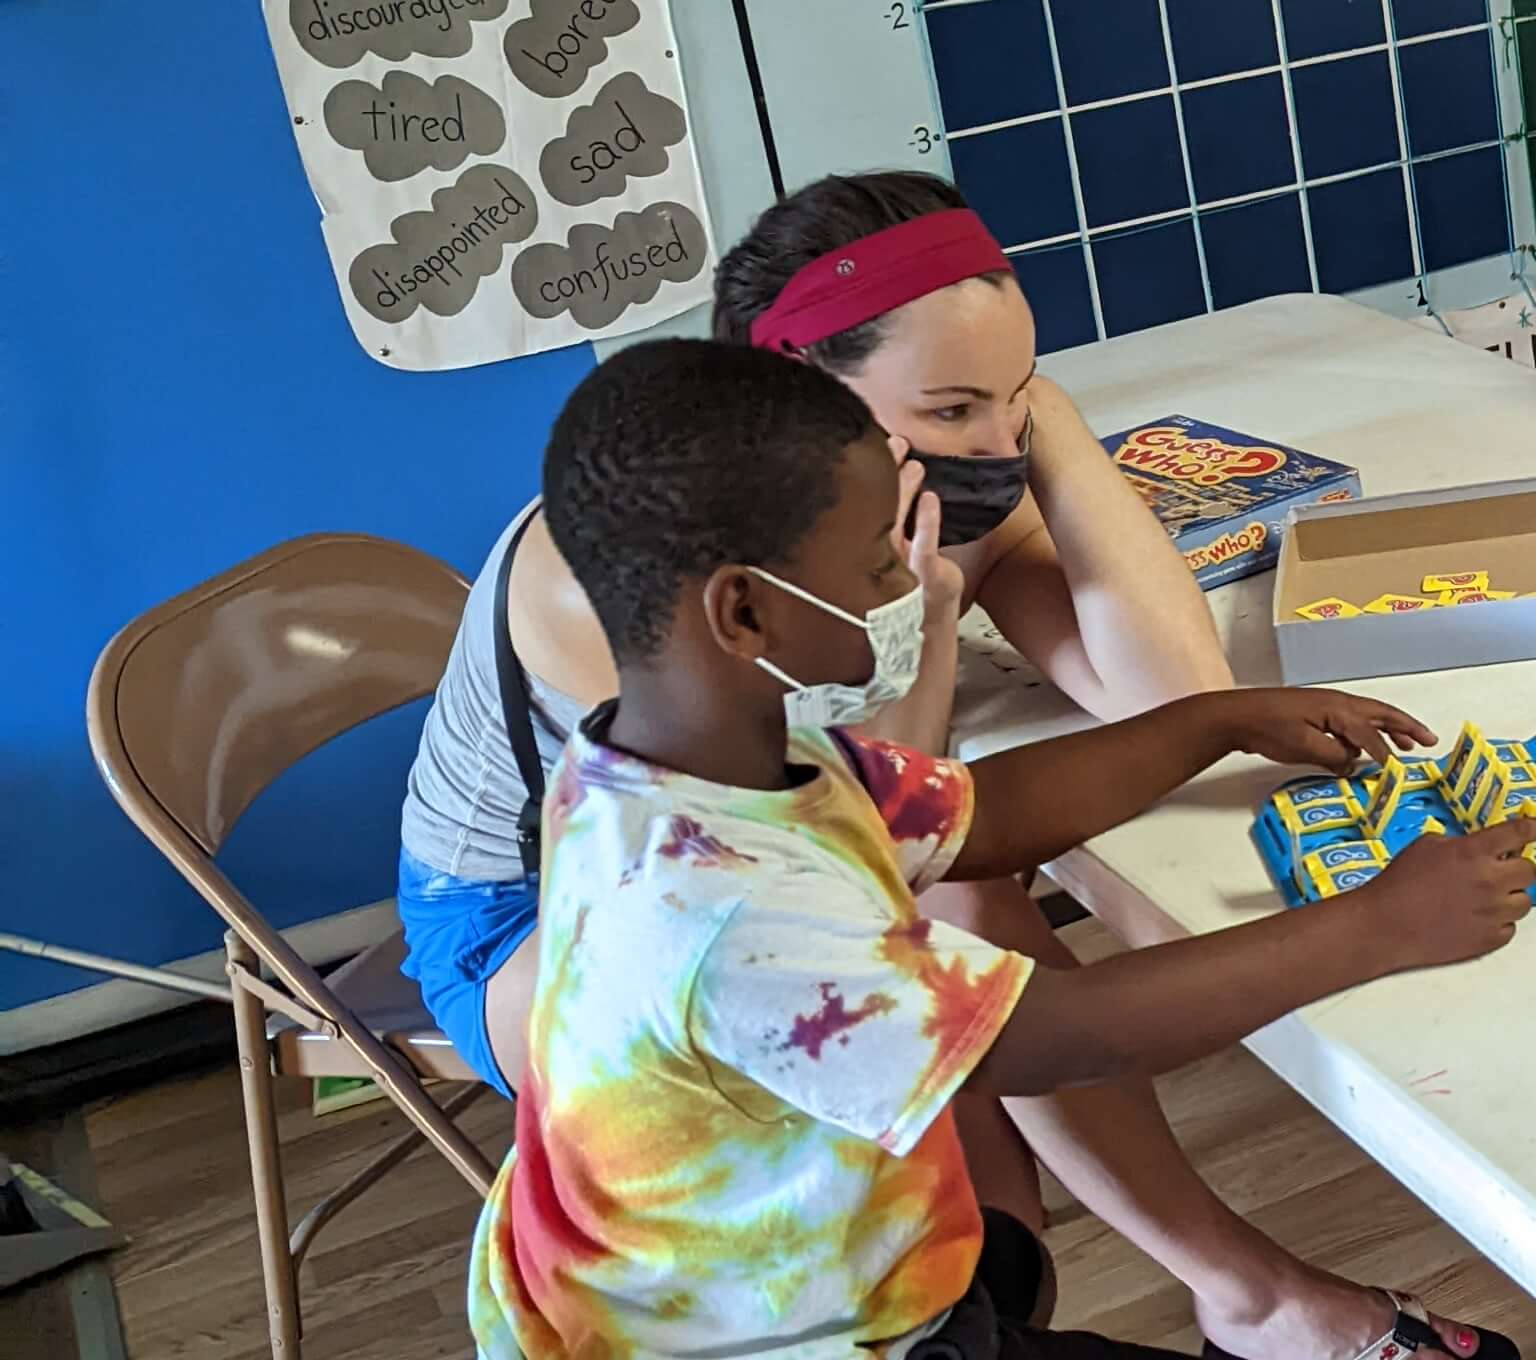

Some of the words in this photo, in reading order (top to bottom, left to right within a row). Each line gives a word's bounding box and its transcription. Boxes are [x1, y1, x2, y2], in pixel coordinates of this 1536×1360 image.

[883, 2, 909, 30] -2
[362, 94, 467, 143] tired
[571, 102, 645, 184] sad
[908, 126, 932, 154] -3
[377, 178, 525, 308] disappointed
[541, 221, 688, 303] confused
